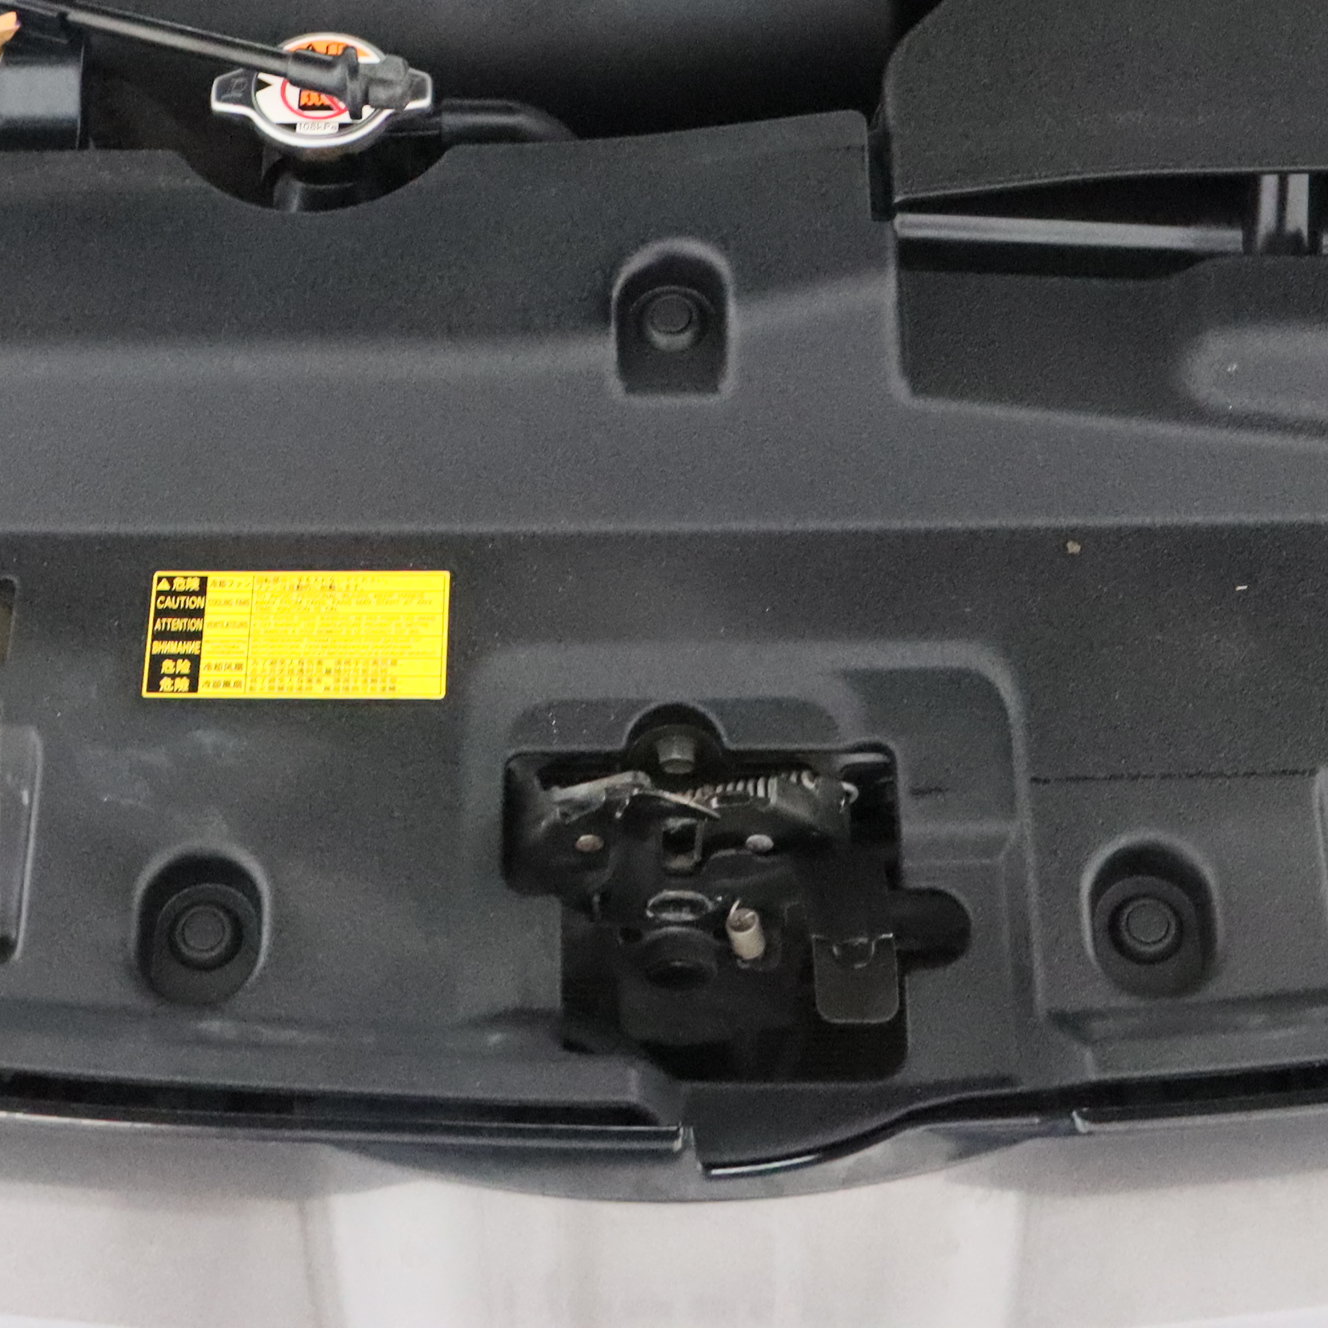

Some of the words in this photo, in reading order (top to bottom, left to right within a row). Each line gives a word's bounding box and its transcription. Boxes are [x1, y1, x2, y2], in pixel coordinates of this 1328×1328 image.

[156, 595, 206, 610] CAUTION
[154, 617, 204, 632] ATTENTION
[152, 640, 201, 655] ВНИМАНИЕ
